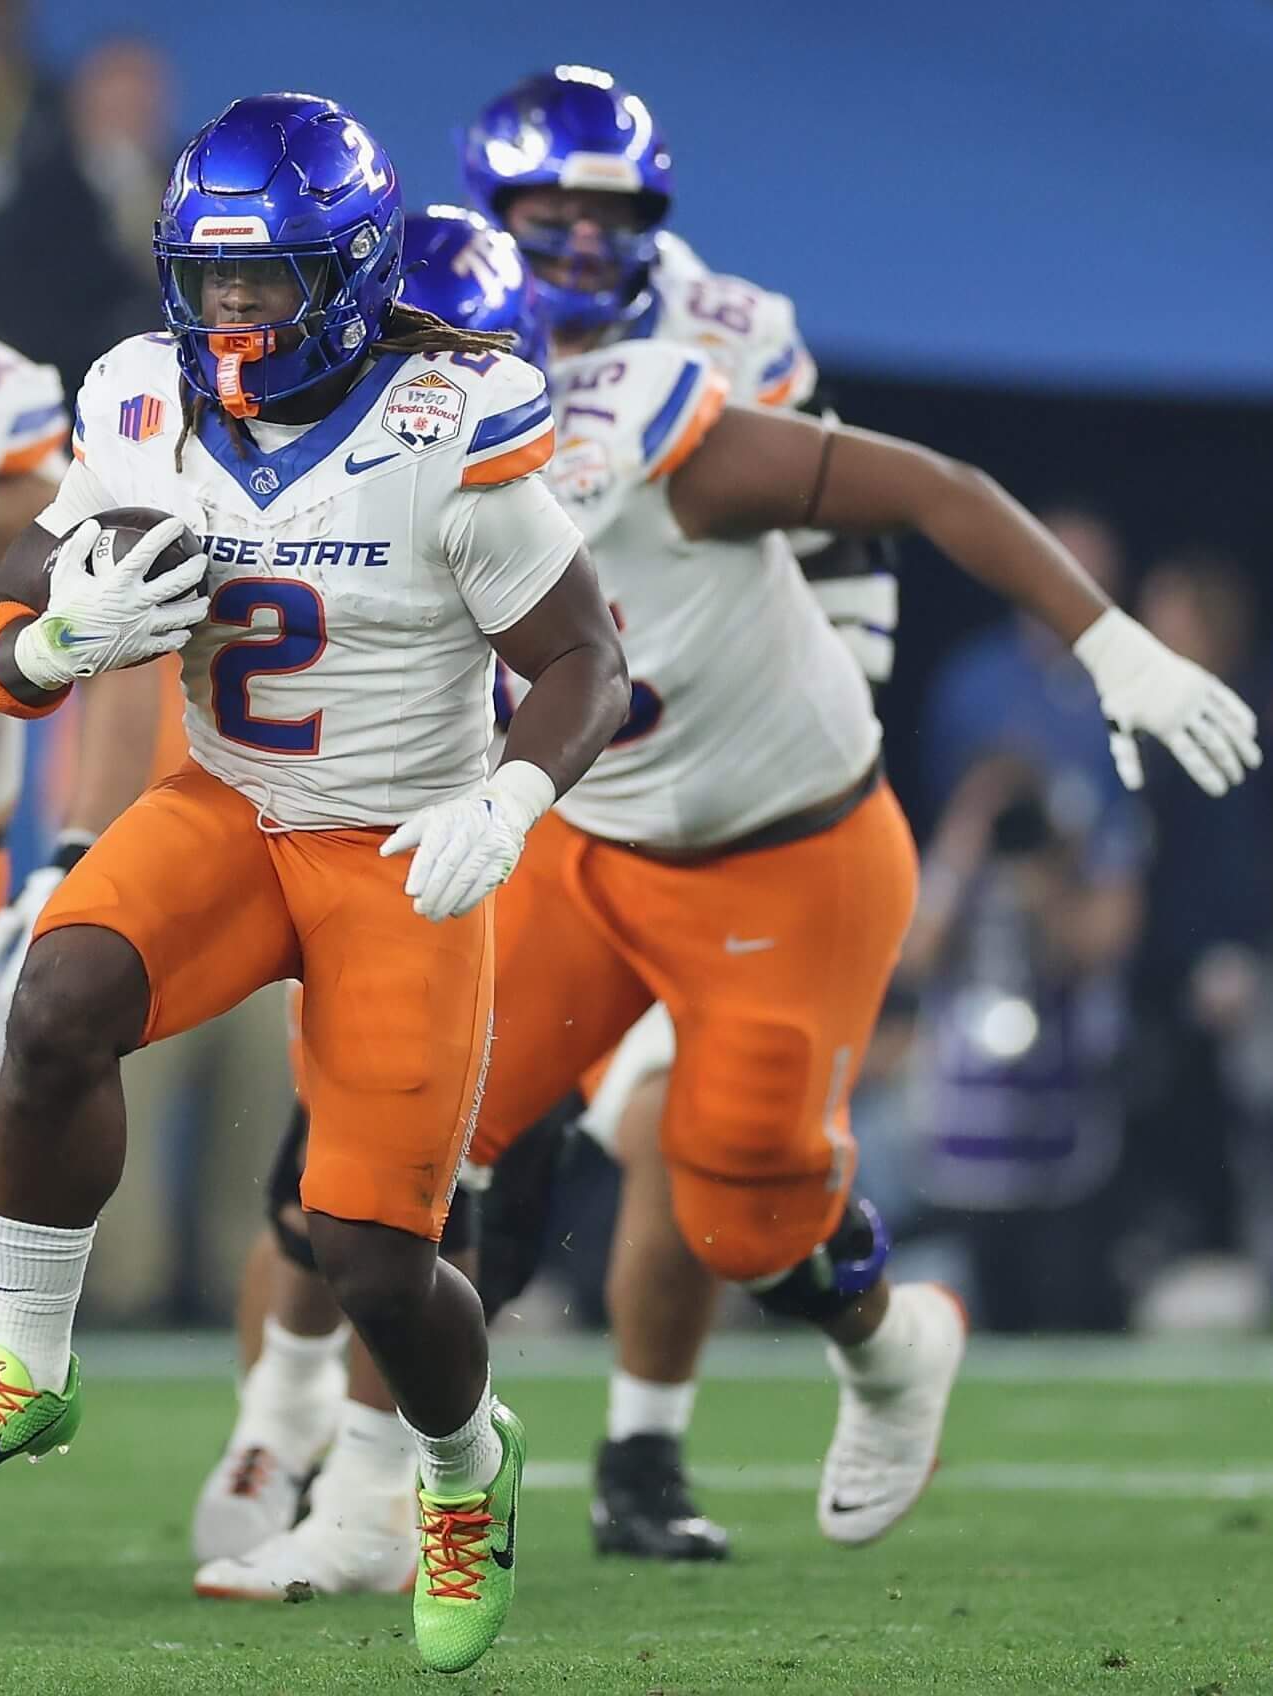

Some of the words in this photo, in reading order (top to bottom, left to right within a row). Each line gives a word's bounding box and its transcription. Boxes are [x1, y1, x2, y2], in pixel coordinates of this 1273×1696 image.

[341, 117, 388, 194] 2
[388, 403, 425, 415] Fiesta
[426, 405, 460, 422] Bowl
[196, 535, 263, 564] ISE
[273, 540, 391, 566] STATE
[209, 576, 328, 756] 2
